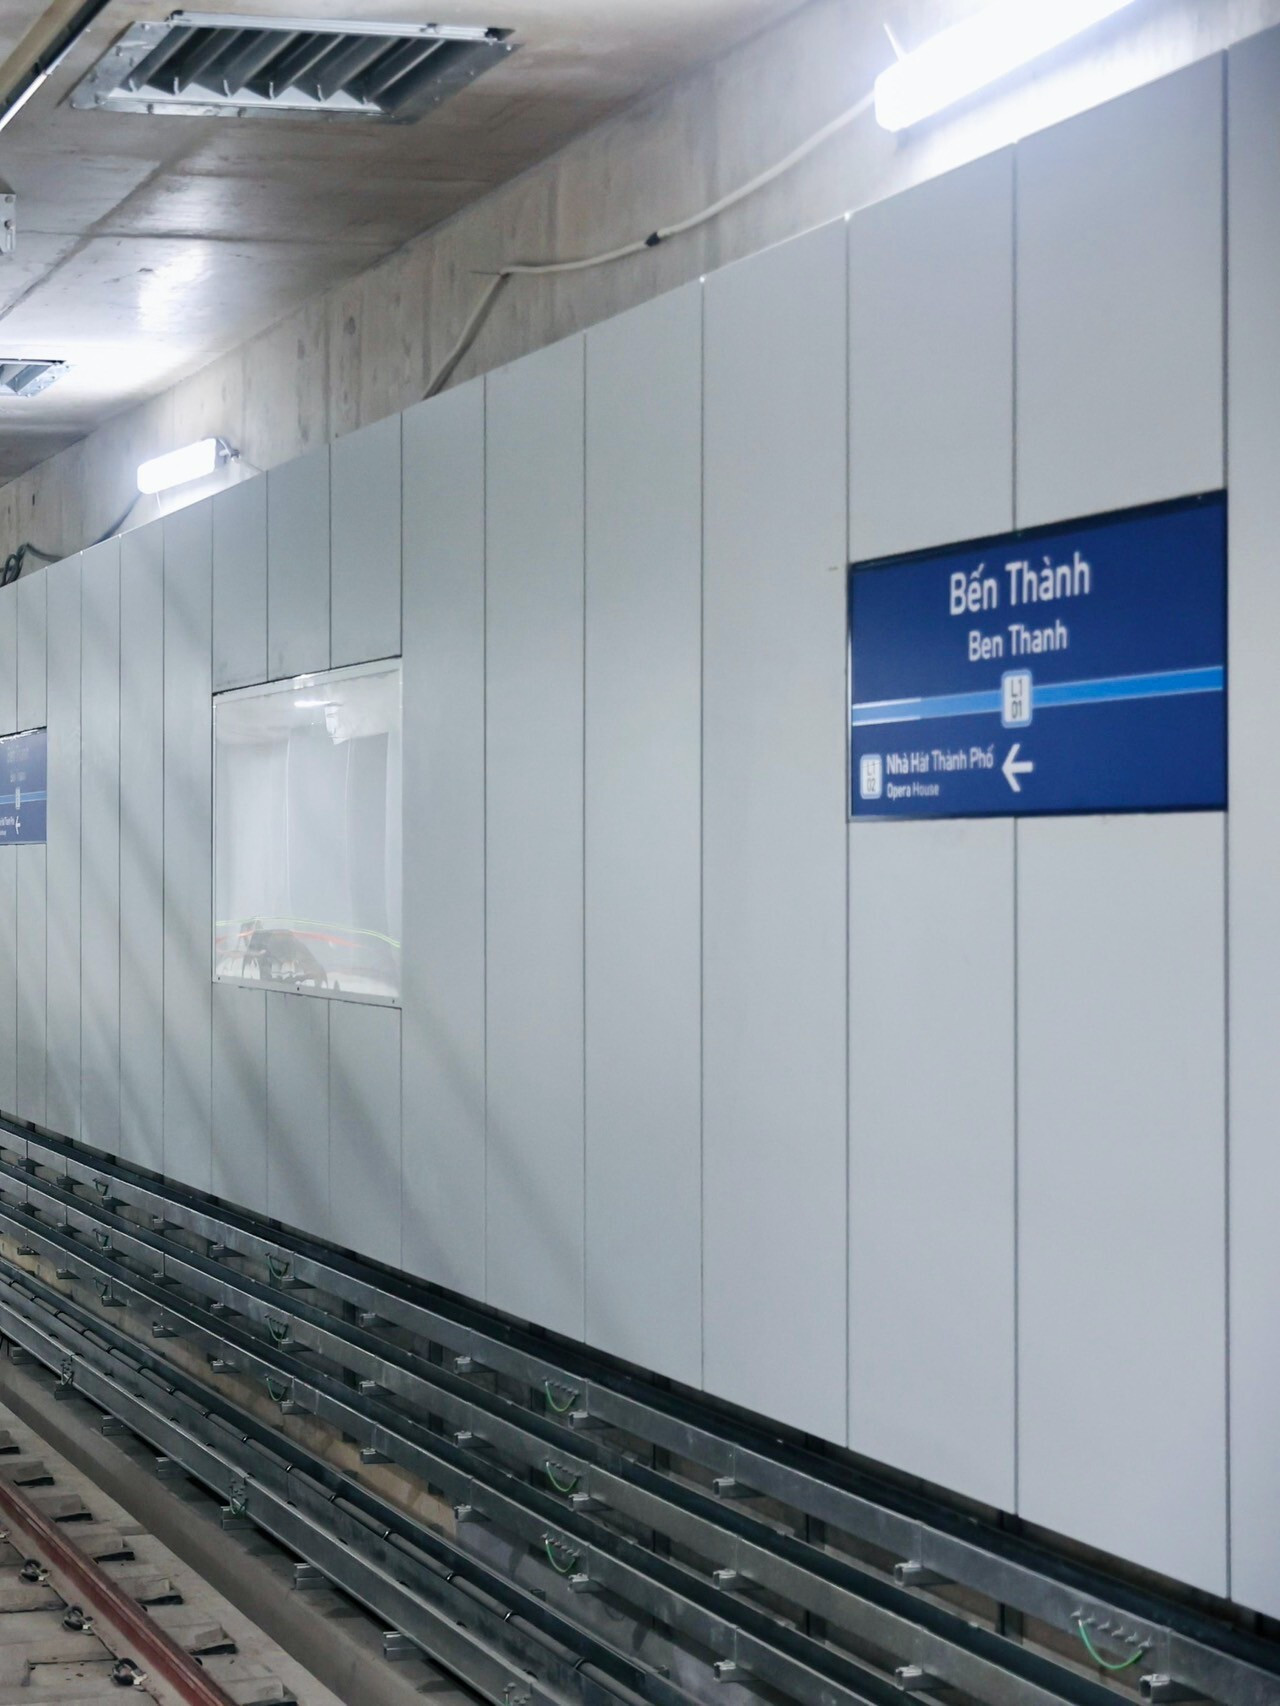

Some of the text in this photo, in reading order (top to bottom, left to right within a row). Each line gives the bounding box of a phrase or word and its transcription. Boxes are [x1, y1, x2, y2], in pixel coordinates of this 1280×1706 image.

[950, 551, 1090, 616] Bến Thành
[968, 619, 1067, 662] Ben Thanh
[1011, 679, 1023, 698] L1
[1011, 700, 1022, 719] 01
[886, 743, 994, 775] Nhà Hát Thành Phố
[887, 782, 939, 800] Opera House
